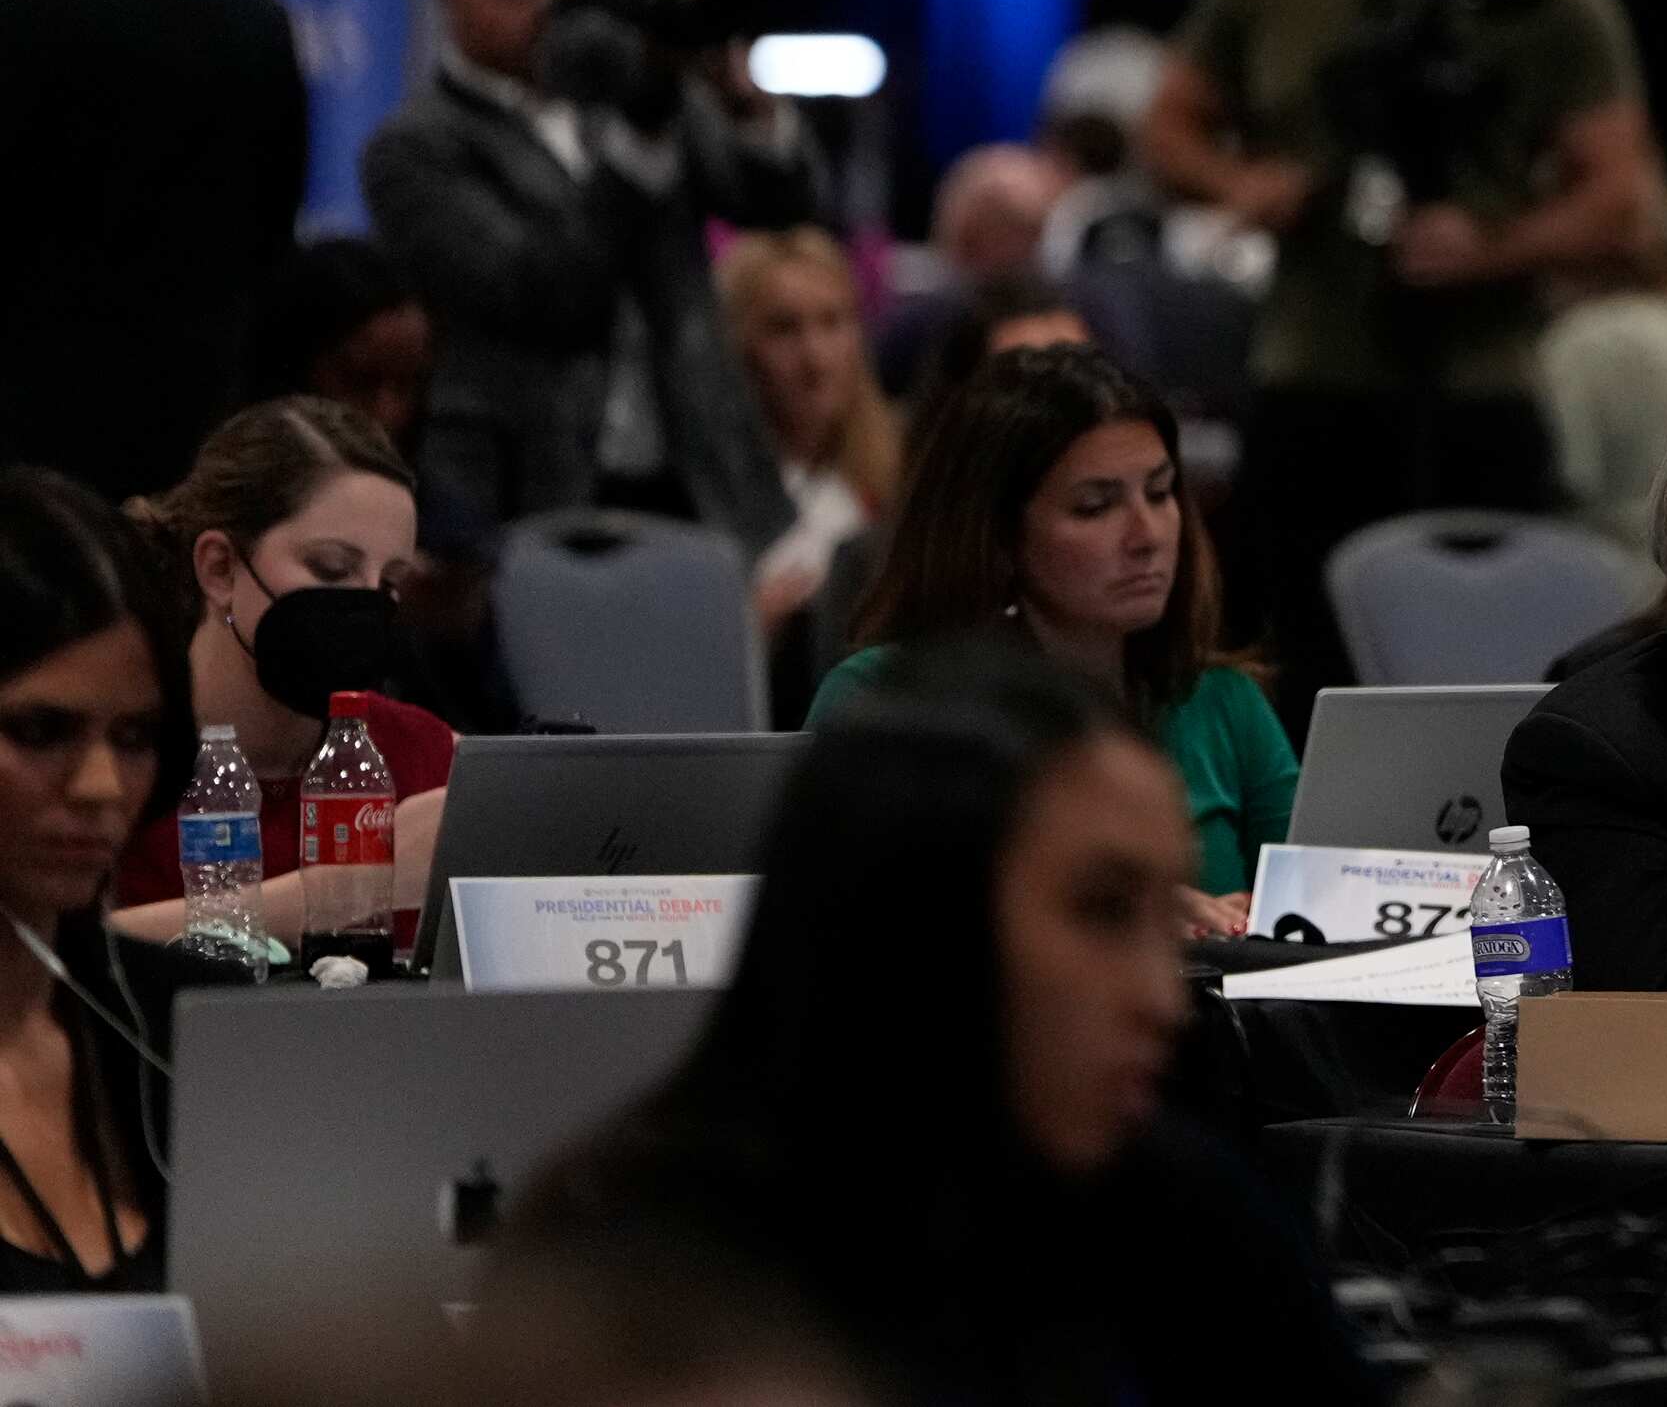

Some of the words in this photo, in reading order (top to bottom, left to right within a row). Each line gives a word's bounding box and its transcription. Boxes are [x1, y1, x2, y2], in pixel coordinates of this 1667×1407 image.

[535, 898, 656, 914] PRESIDENTIAL
[658, 898, 723, 914] DEBATE
[1374, 901, 1471, 939] 87
[1474, 940, 1521, 955] RATOGA
[585, 939, 688, 987] 871
